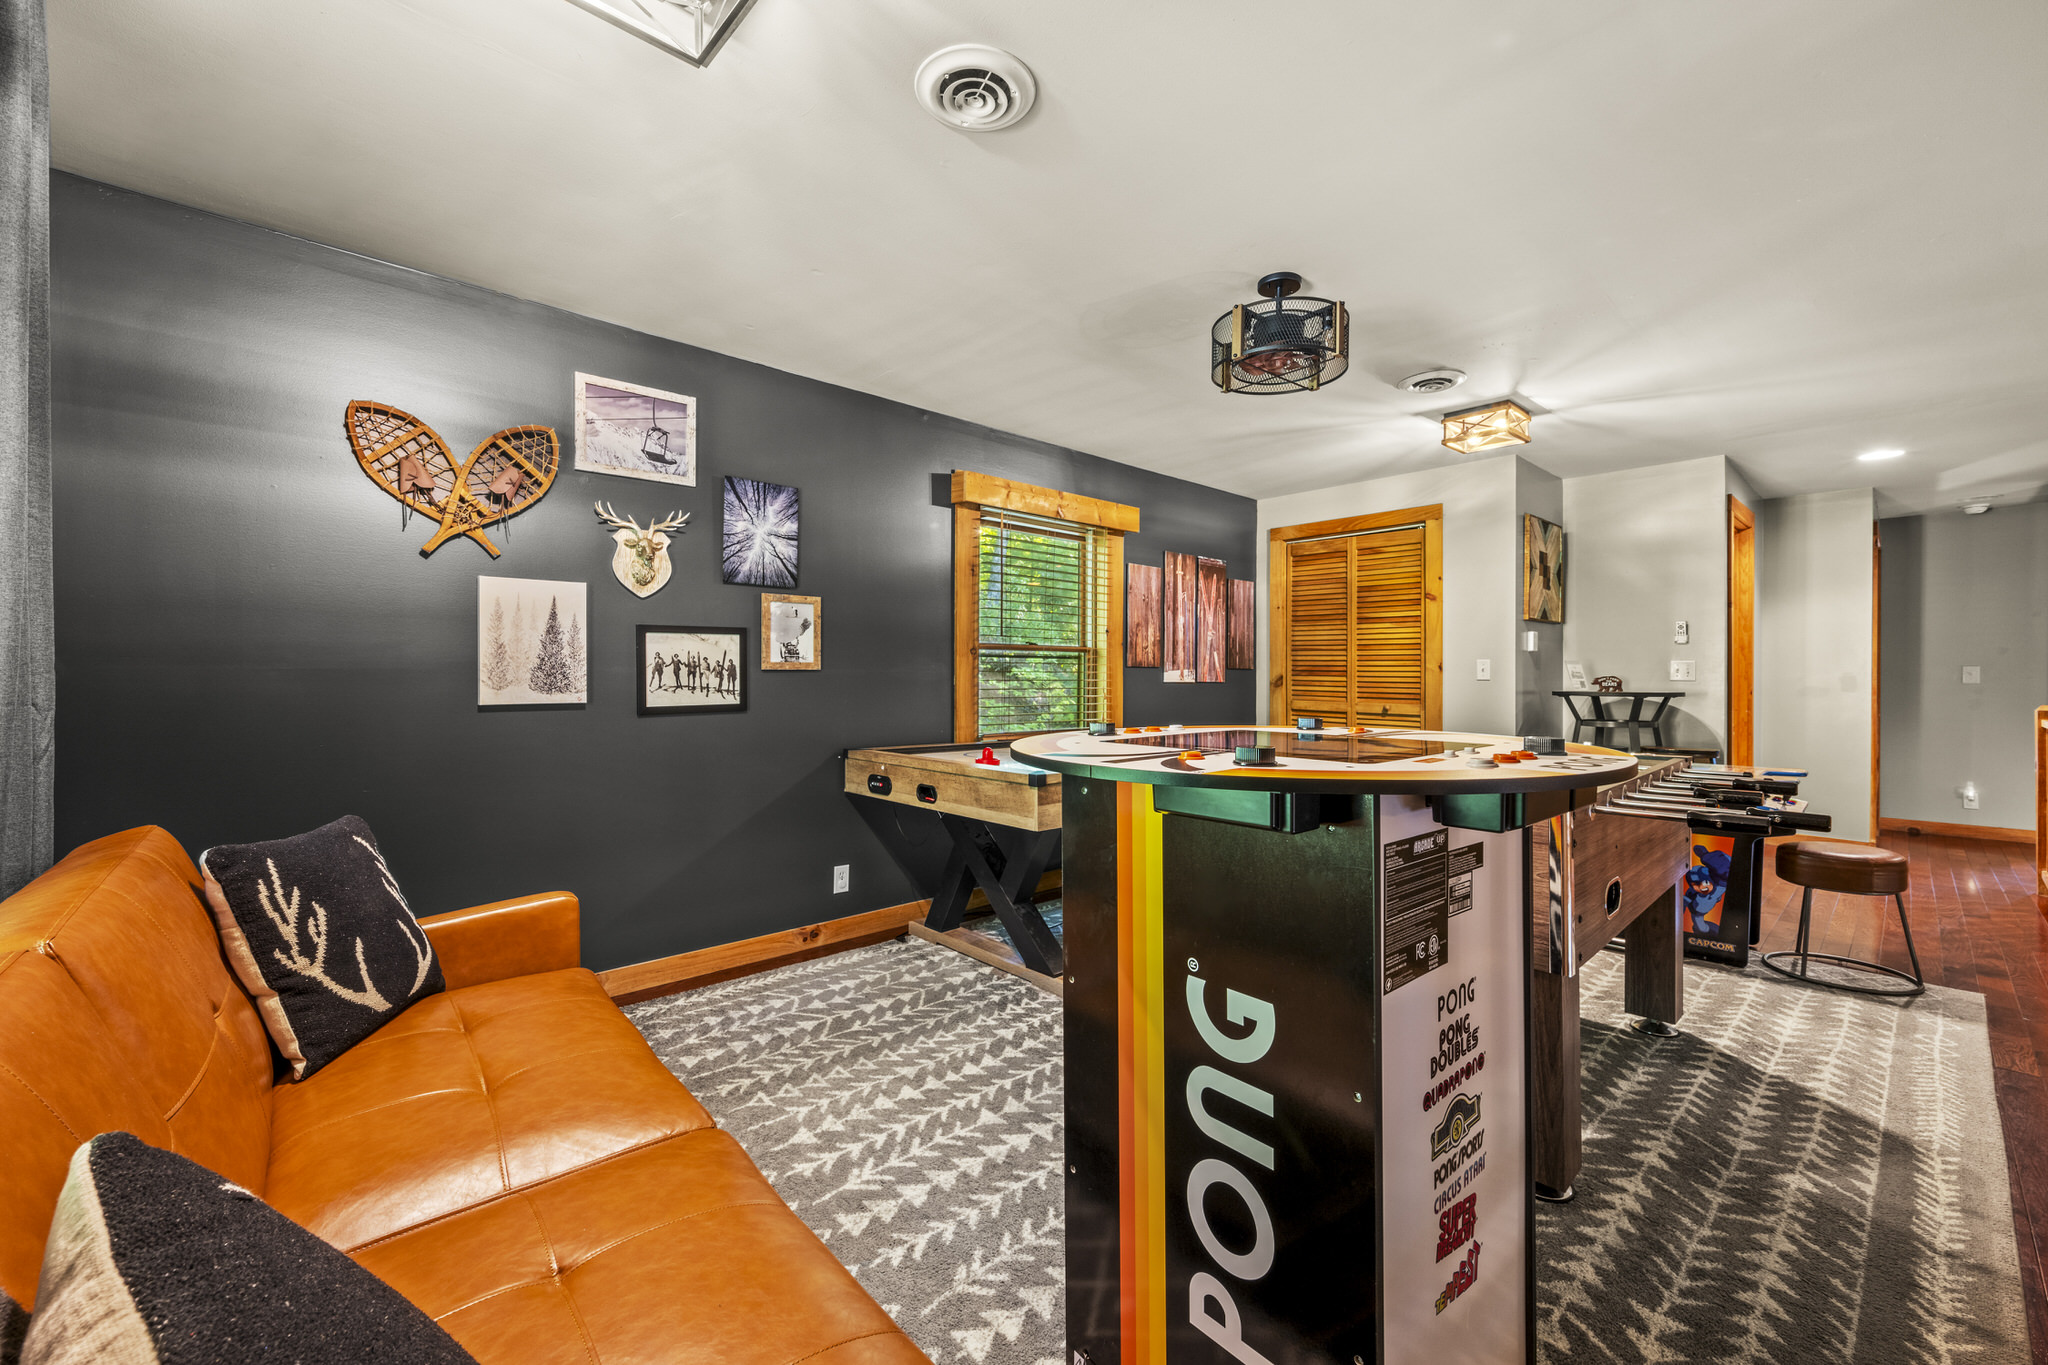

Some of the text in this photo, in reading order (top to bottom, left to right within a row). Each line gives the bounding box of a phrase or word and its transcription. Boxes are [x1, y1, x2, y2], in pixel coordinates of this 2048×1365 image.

[1688, 937, 1736, 953] CAPCOM
[1438, 977, 1475, 1022] PONG
[1430, 1028, 1480, 1080] DOUBLES
[1439, 1013, 1471, 1052] PONG
[1423, 1052, 1485, 1112] QUADRAPONG
[1186, 974, 1276, 1365] PONG
[1434, 1155, 1487, 1214] CIRCUS ATARI
[1435, 1220, 1477, 1265] BREAKOUT
[1439, 1192, 1477, 1243] SUPER
[1434, 1239, 1482, 1316] TEMPEST
